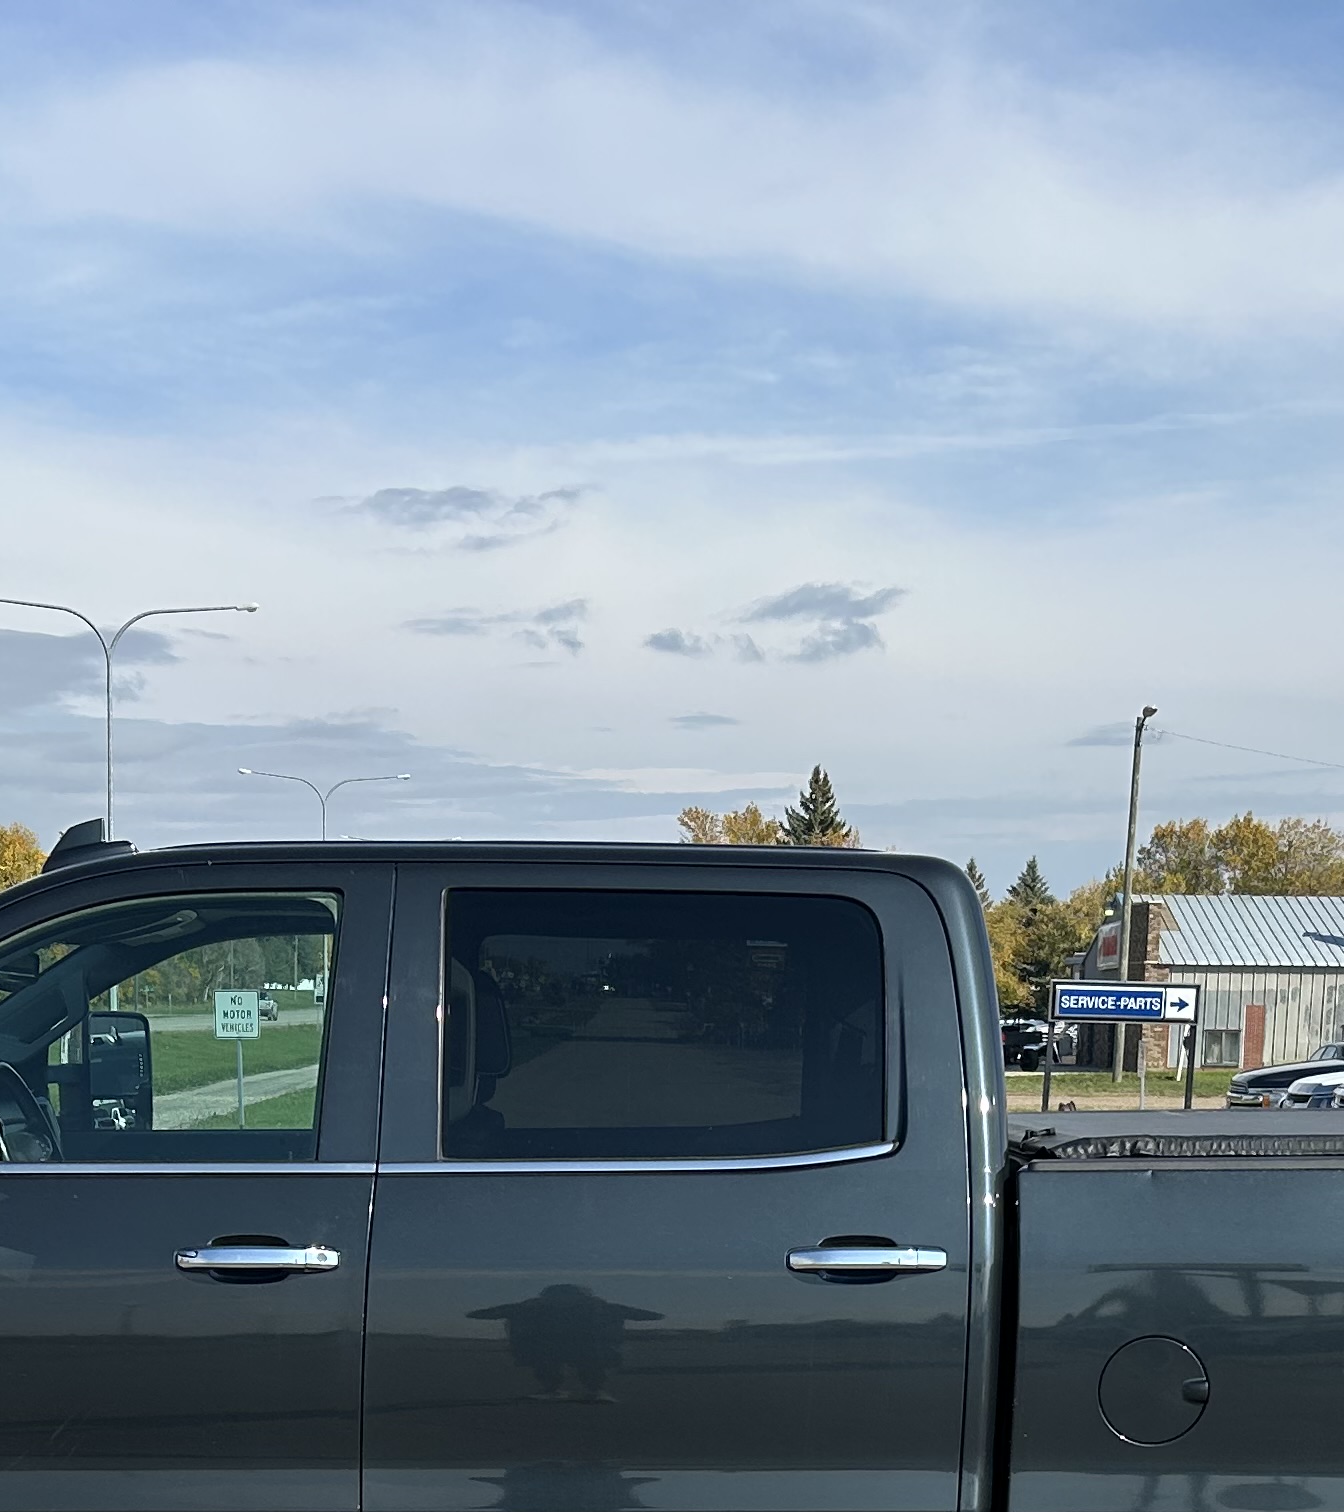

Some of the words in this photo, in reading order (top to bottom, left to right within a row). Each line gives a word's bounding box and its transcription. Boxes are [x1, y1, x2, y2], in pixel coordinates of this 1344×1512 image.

[230, 996, 243, 1006] NO
[1060, 994, 1162, 1011] SERVICE-PARTS
[222, 1009, 253, 1020] MOTOR
[221, 1023, 254, 1033] VEHICLES
